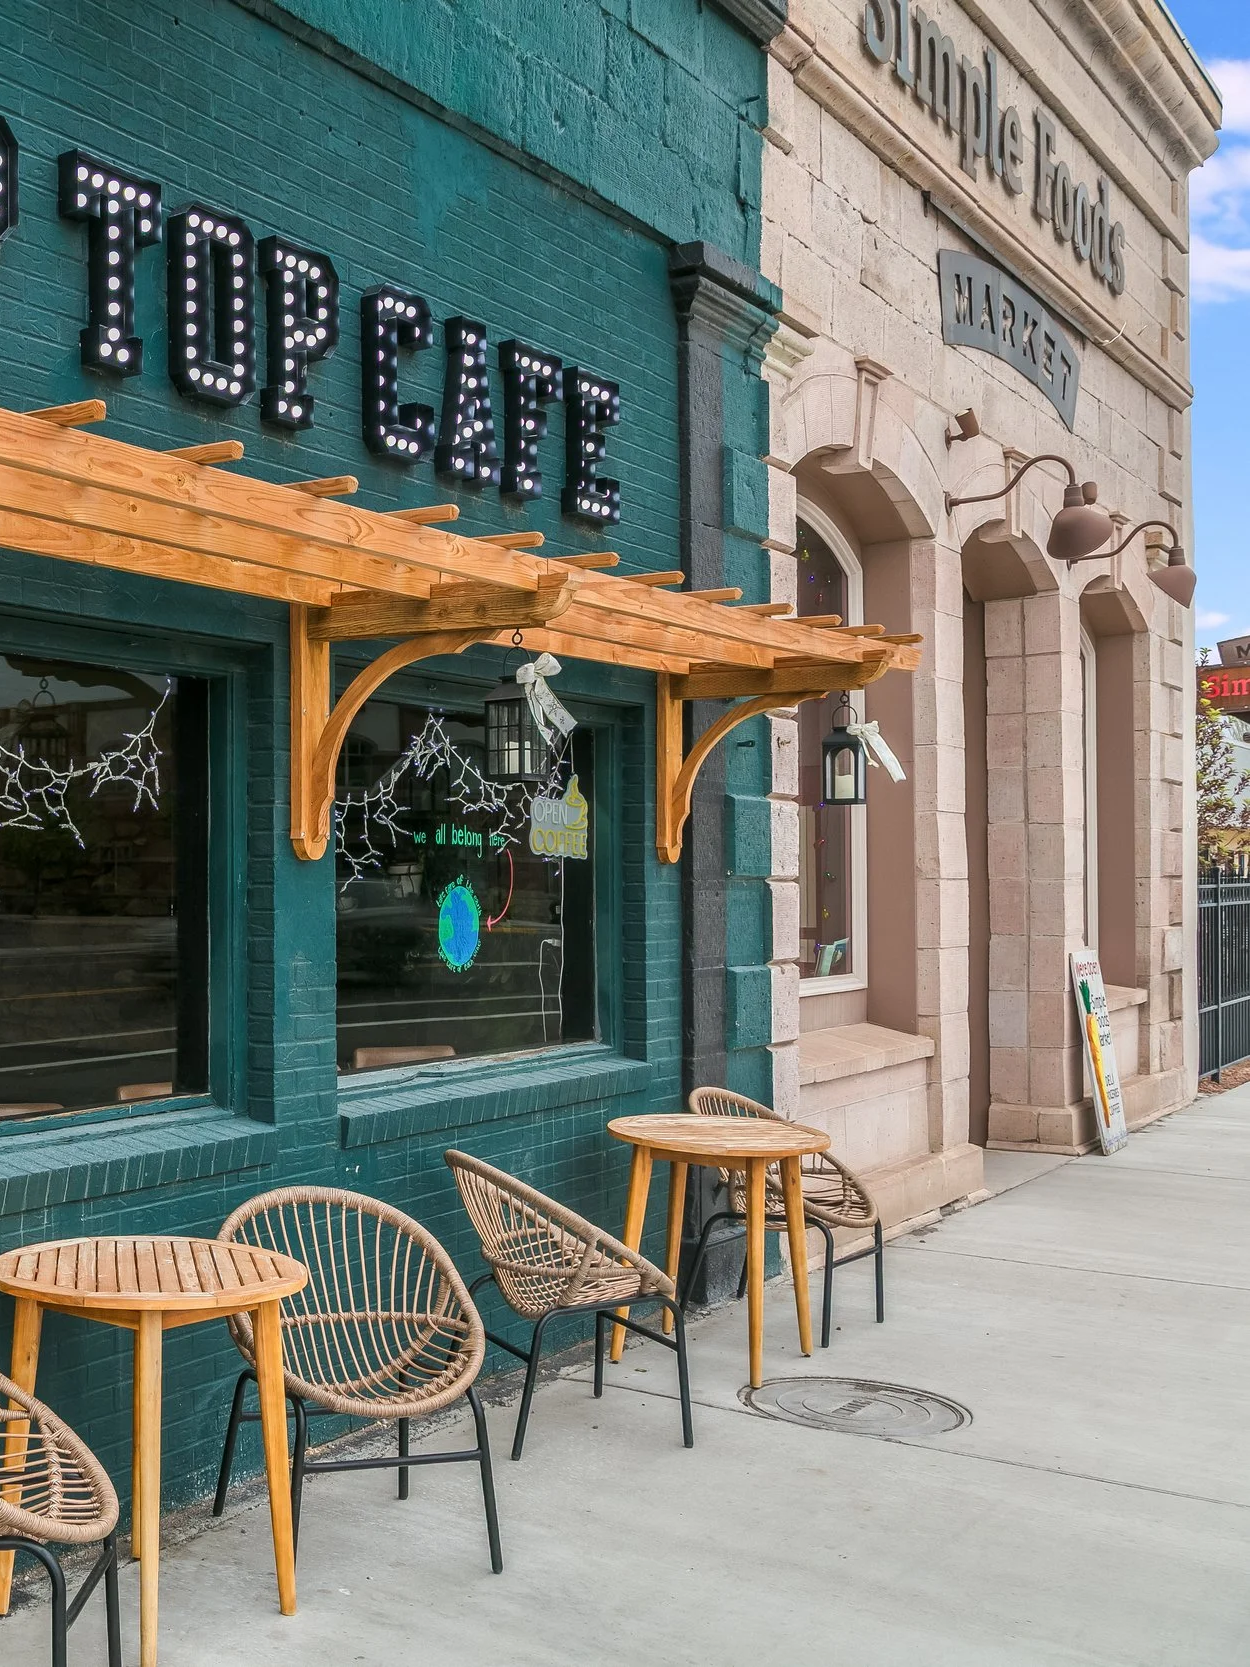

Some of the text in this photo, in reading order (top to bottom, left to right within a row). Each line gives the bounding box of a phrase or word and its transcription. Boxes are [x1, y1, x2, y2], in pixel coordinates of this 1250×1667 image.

[864, 0, 1126, 296] Simple Foods
[58, 148, 340, 431] TOP
[360, 283, 620, 526] CAFE
[953, 272, 1074, 401] MARKET
[413, 823, 505, 858] we all belong here
[532, 828, 587, 856] COFFEE
[534, 800, 568, 825] OPEN
